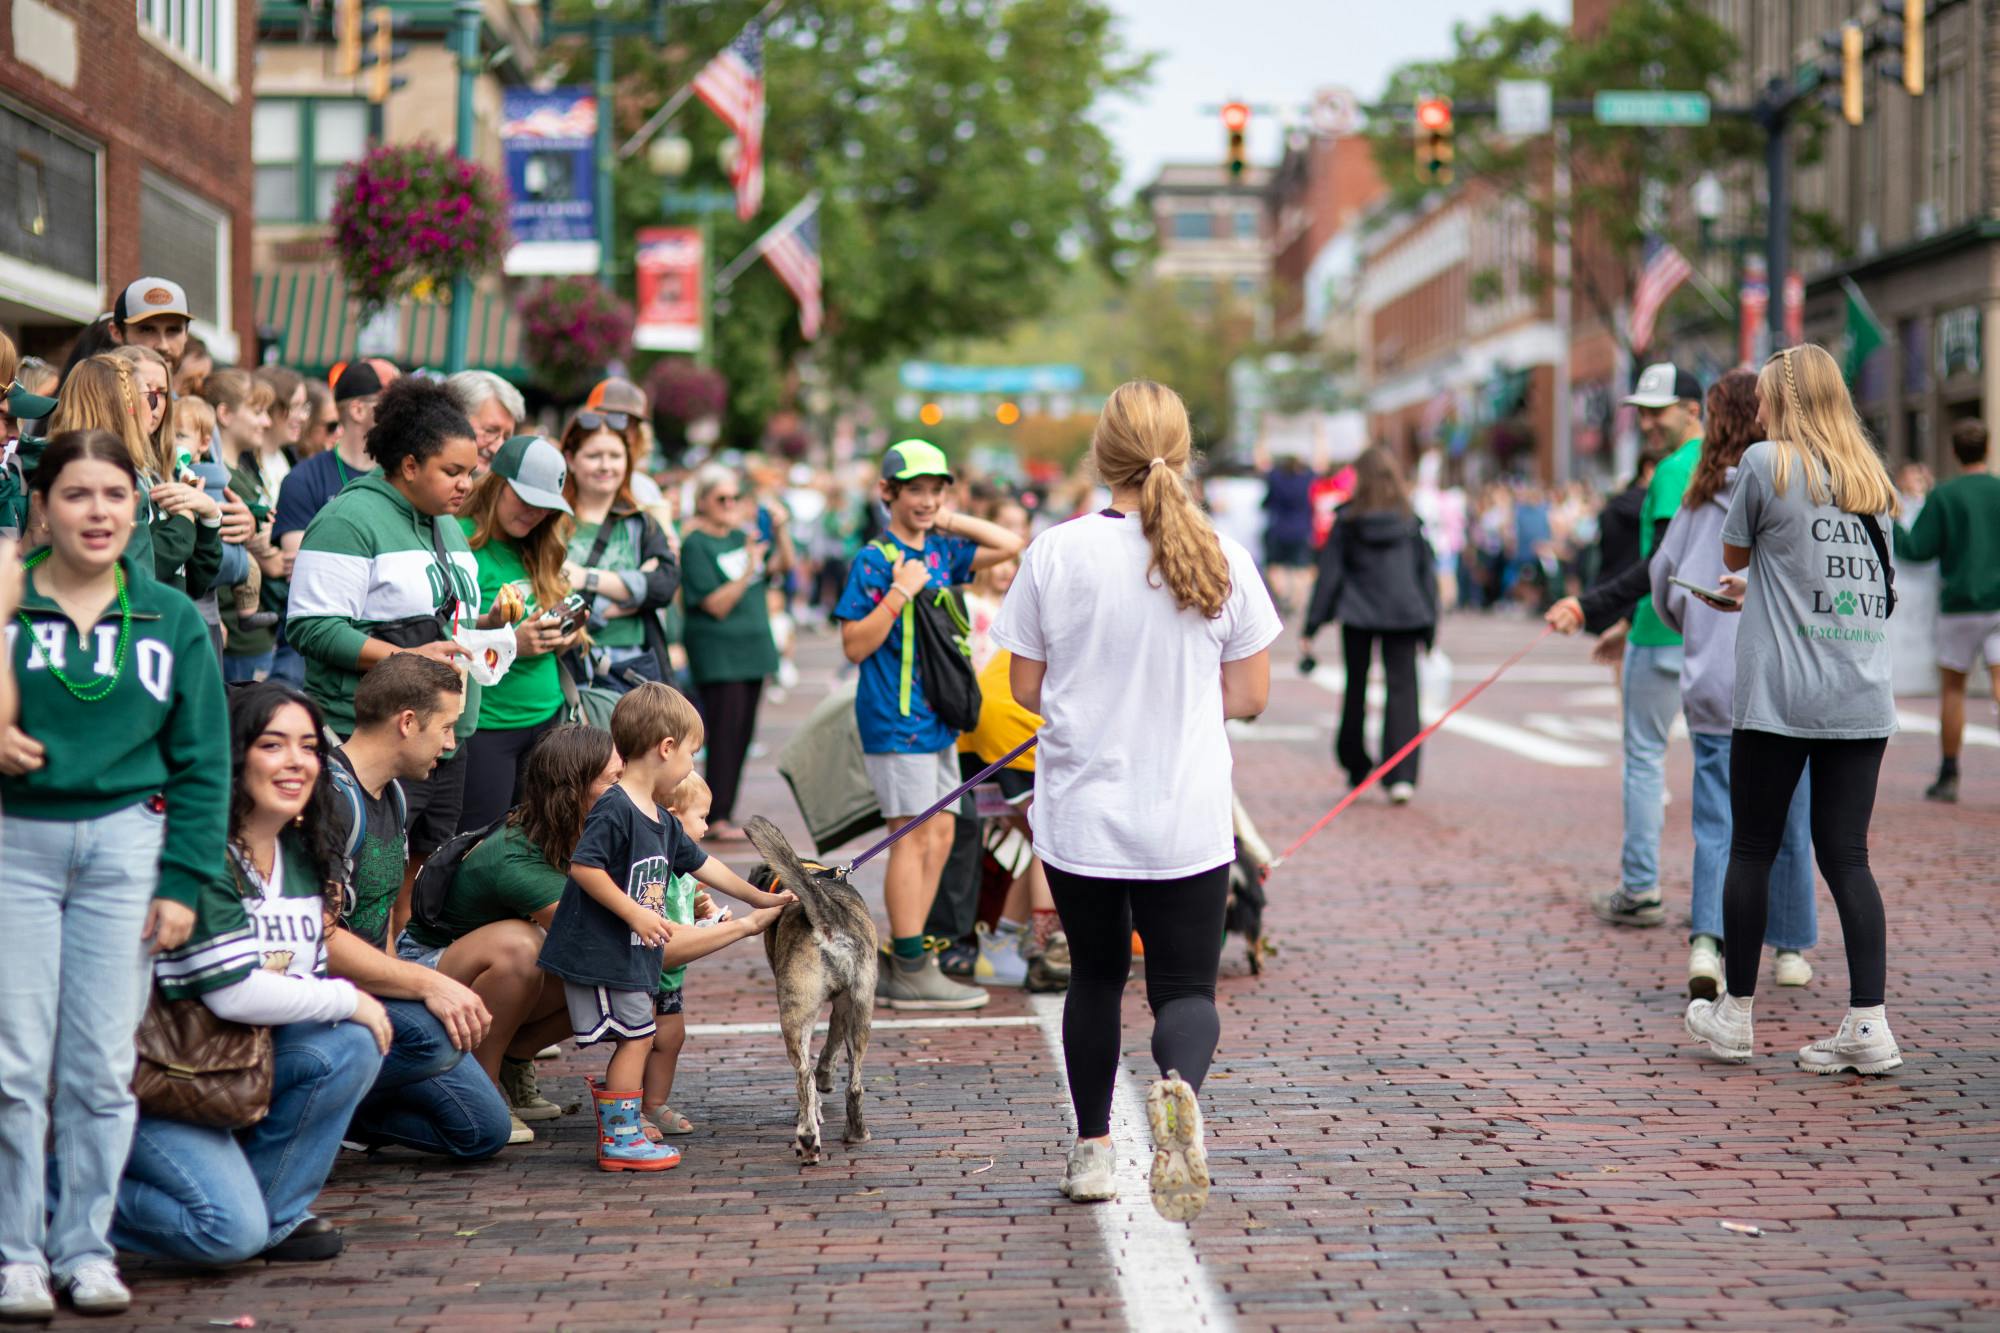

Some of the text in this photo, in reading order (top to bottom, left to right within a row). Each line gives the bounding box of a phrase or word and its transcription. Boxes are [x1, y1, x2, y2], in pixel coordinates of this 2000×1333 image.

[1811, 518, 1887, 546] CAN
[1825, 555, 1880, 582] BUY
[426, 562, 477, 609] OIO
[1812, 590, 1886, 619] LVE
[1819, 625, 1840, 640] YOU
[1844, 628, 1862, 643] CAN
